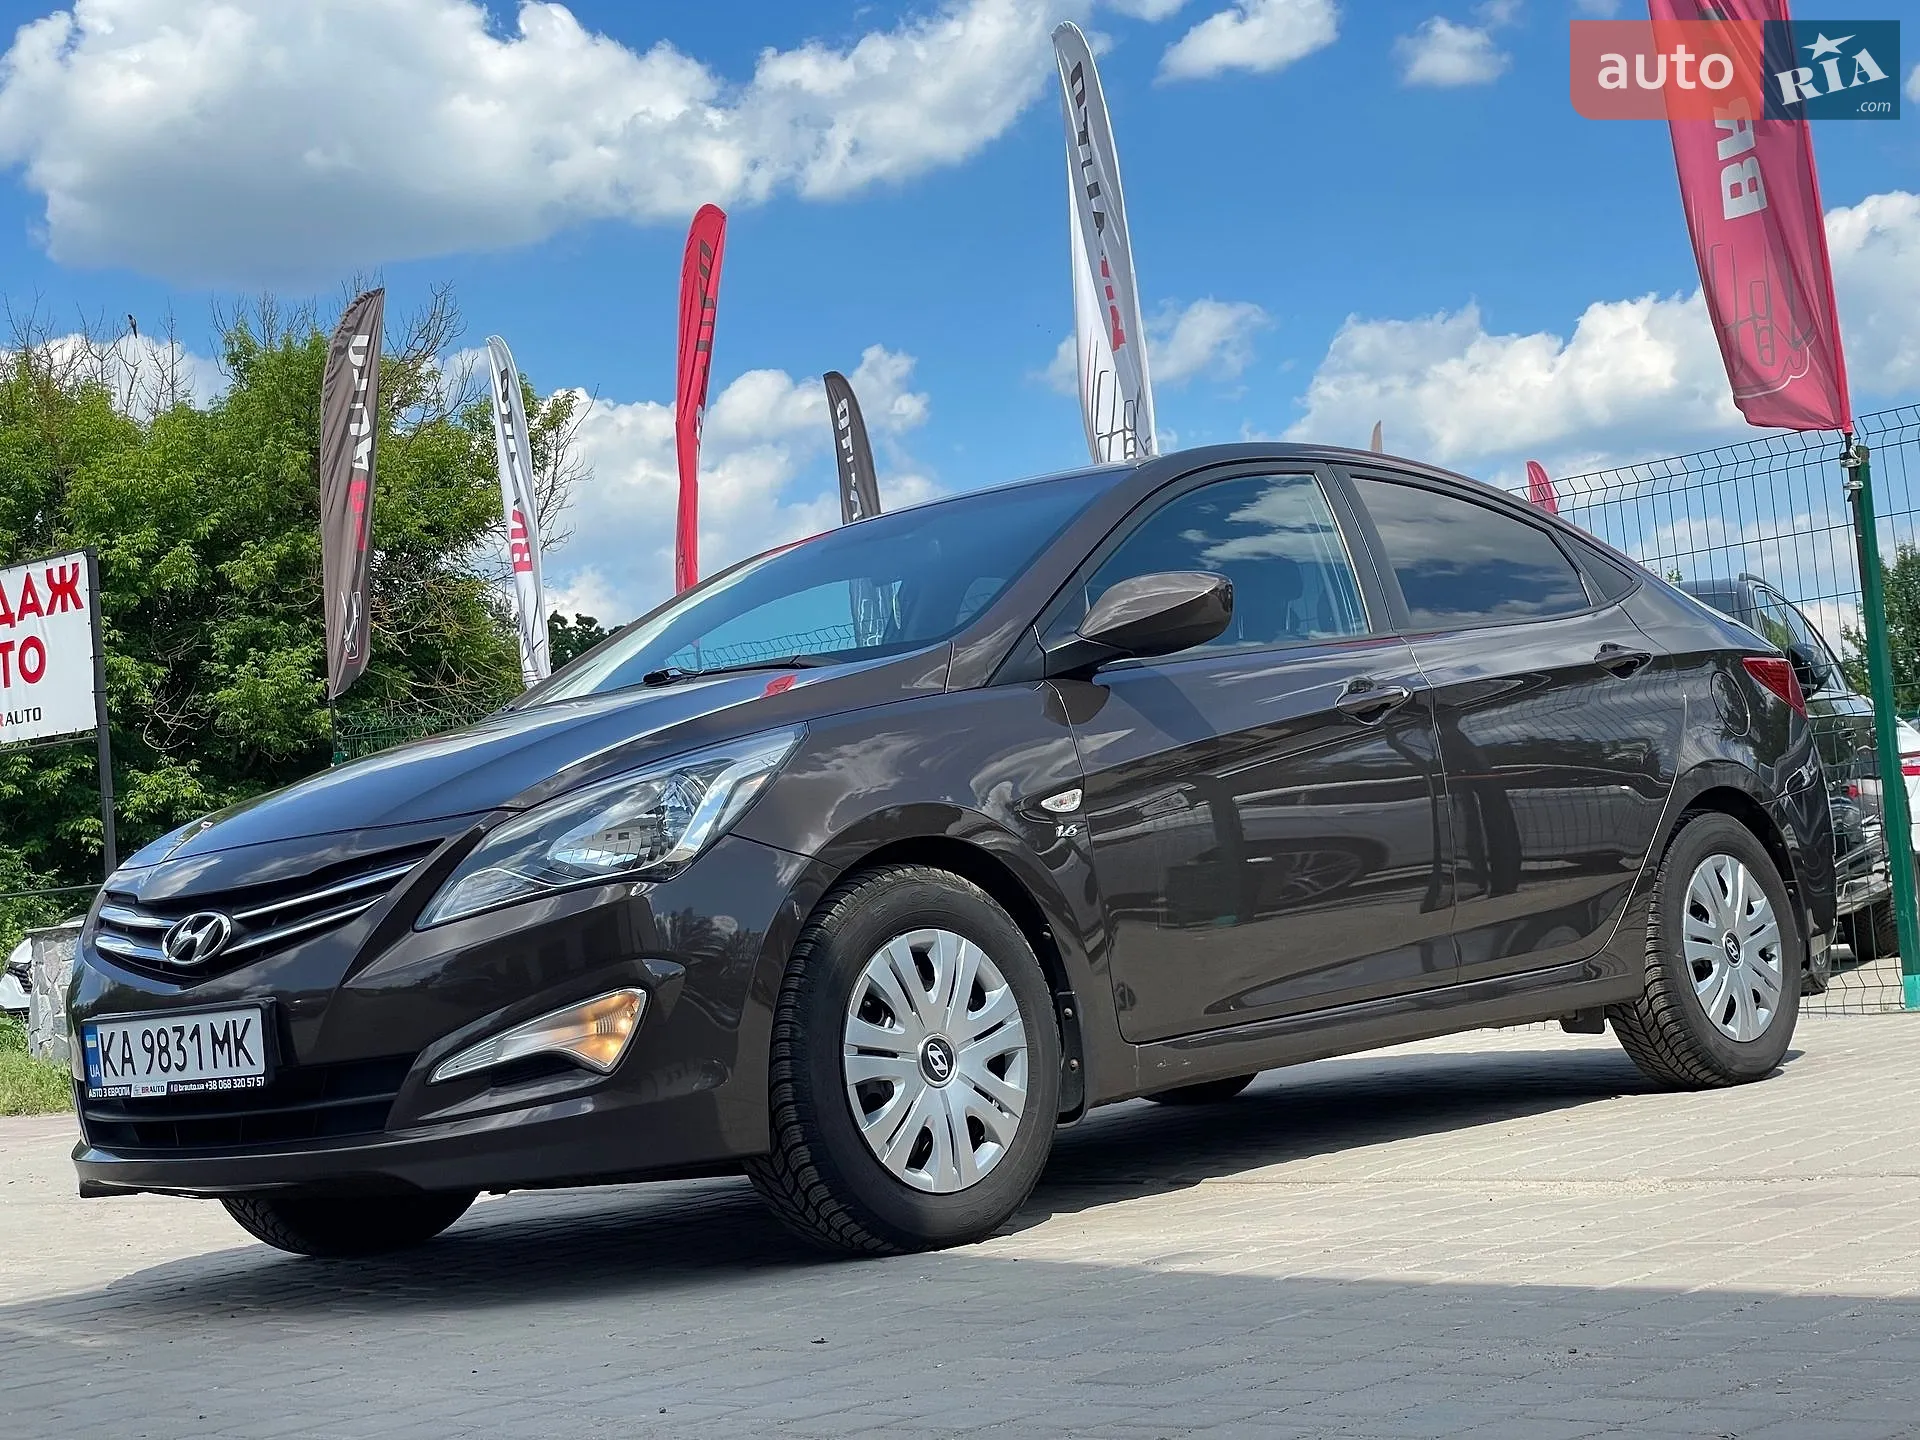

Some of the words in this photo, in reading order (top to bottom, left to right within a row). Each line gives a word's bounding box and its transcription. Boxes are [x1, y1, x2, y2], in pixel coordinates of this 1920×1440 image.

[100, 1030, 137, 1077] KA
[141, 1023, 204, 1074] 9831
[209, 1018, 256, 1069] MK
[90, 1064, 101, 1078] UA
[232, 1078, 246, 1089] 320
[246, 1077, 255, 1088] 57
[256, 1076, 265, 1087] 57
